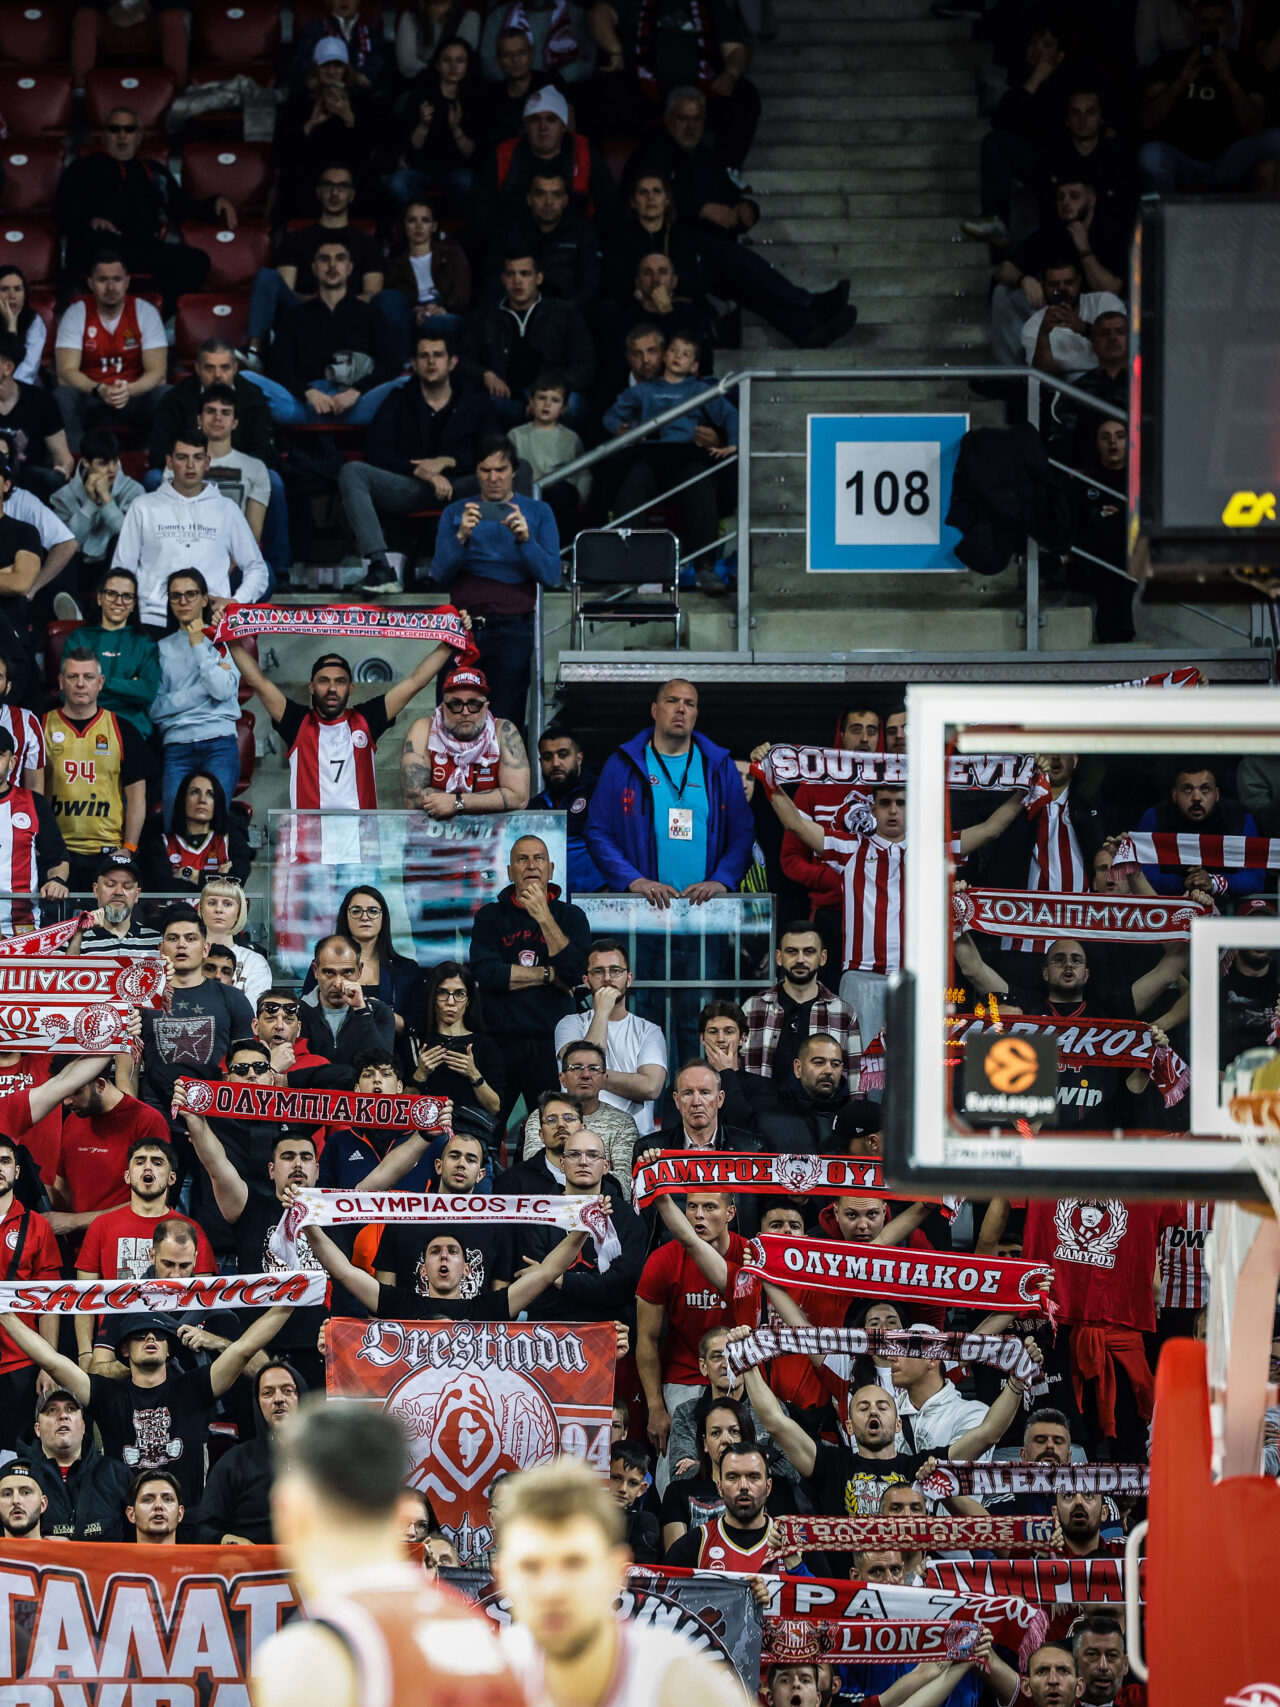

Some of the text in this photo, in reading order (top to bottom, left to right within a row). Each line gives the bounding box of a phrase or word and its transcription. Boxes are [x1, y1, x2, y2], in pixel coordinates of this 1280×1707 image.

[846, 470, 930, 516] 108
[64, 760, 96, 785] 94
[330, 759, 346, 783] 7
[52, 793, 111, 818] bwin
[216, 1087, 411, 1126] ΟΛΥΜΠΙΑΚΟΣ
[1055, 1078, 1103, 1107] win
[643, 1158, 773, 1192] ΑΛΜΥΡΟΣ
[336, 1197, 551, 1214] OLYMPIACOS F.C.
[783, 1247, 1003, 1295] ΟΛΥΜΠΙΑΚΟΣ
[1055, 1245, 1115, 1268] ΑΛΜΥΡΟΣ
[358, 1321, 587, 1373] Orestiada
[726, 1328, 1038, 1380] PARANOID GROU
[561, 1421, 611, 1472] 94
[812, 1522, 1013, 1538] ΟΛΥΜΠΙΑΚΟΣ
[841, 1624, 945, 1653] LIONS
